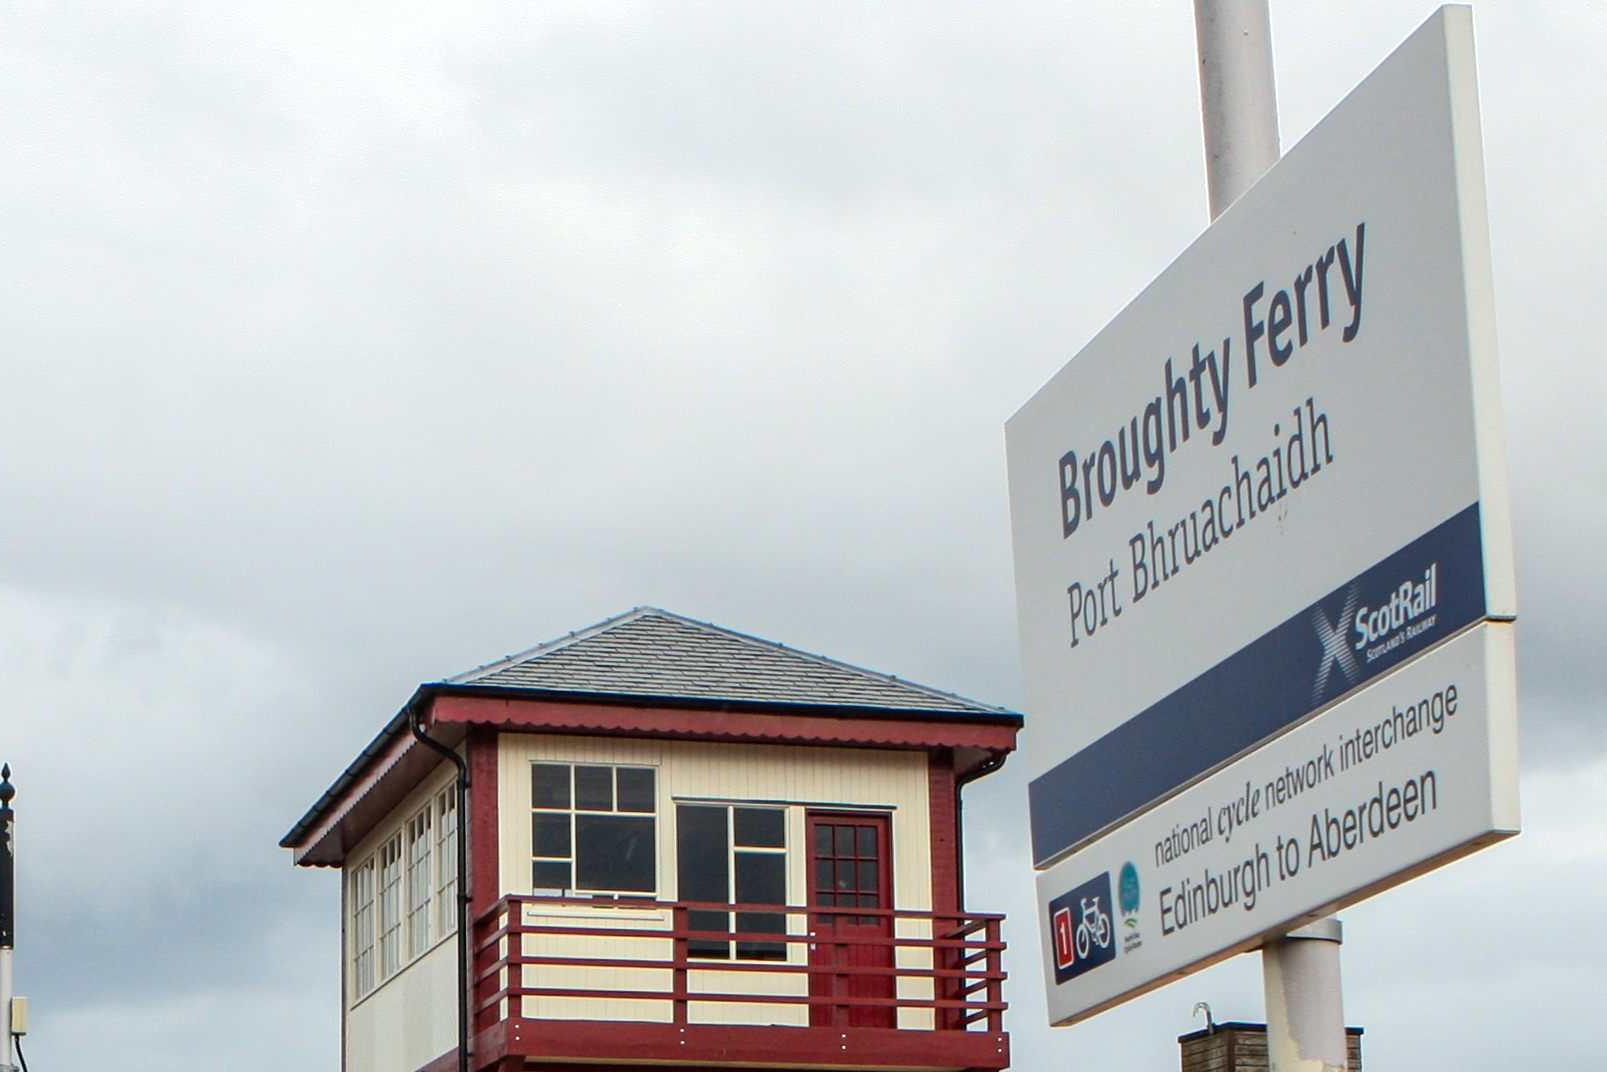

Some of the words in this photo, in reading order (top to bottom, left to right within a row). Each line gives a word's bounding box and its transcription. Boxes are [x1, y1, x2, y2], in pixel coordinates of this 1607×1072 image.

[1059, 337, 1231, 540] Broughty
[1243, 221, 1366, 389] Ferry
[1067, 558, 1122, 649] Port
[1129, 397, 1334, 603] Bhruachaidh
[1355, 562, 1437, 650] ScotRail
[1155, 807, 1213, 867] national
[1217, 781, 1260, 843] cycle
[1265, 744, 1335, 811] network
[1339, 684, 1458, 772] interchange
[1159, 843, 1270, 936] Edinburgh
[1276, 835, 1300, 881] to
[1307, 770, 1437, 868] Aberdeen
[1060, 922, 1067, 955] 1
